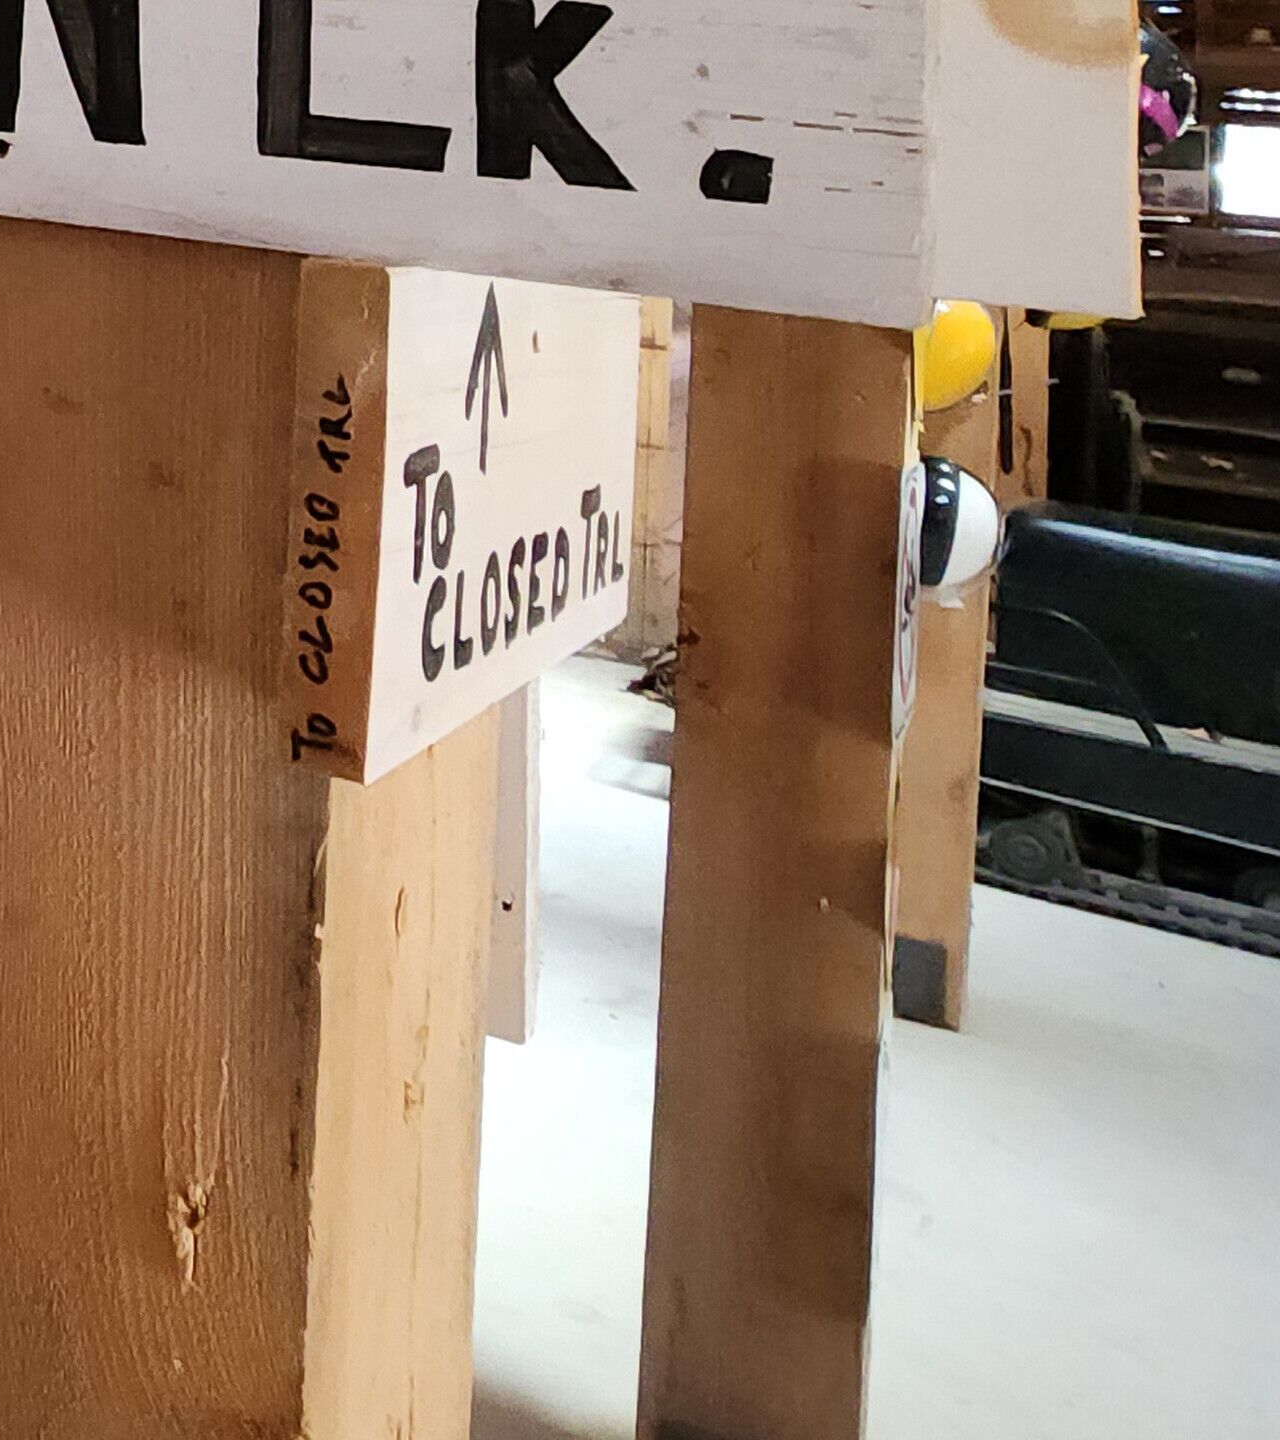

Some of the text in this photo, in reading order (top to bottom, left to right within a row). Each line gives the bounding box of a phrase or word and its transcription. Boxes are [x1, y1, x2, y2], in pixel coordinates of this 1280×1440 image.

[291, 374, 353, 761] TO CLOSED TRL
[403, 443, 455, 585] TO
[421, 483, 624, 683] CLOSED TRL
